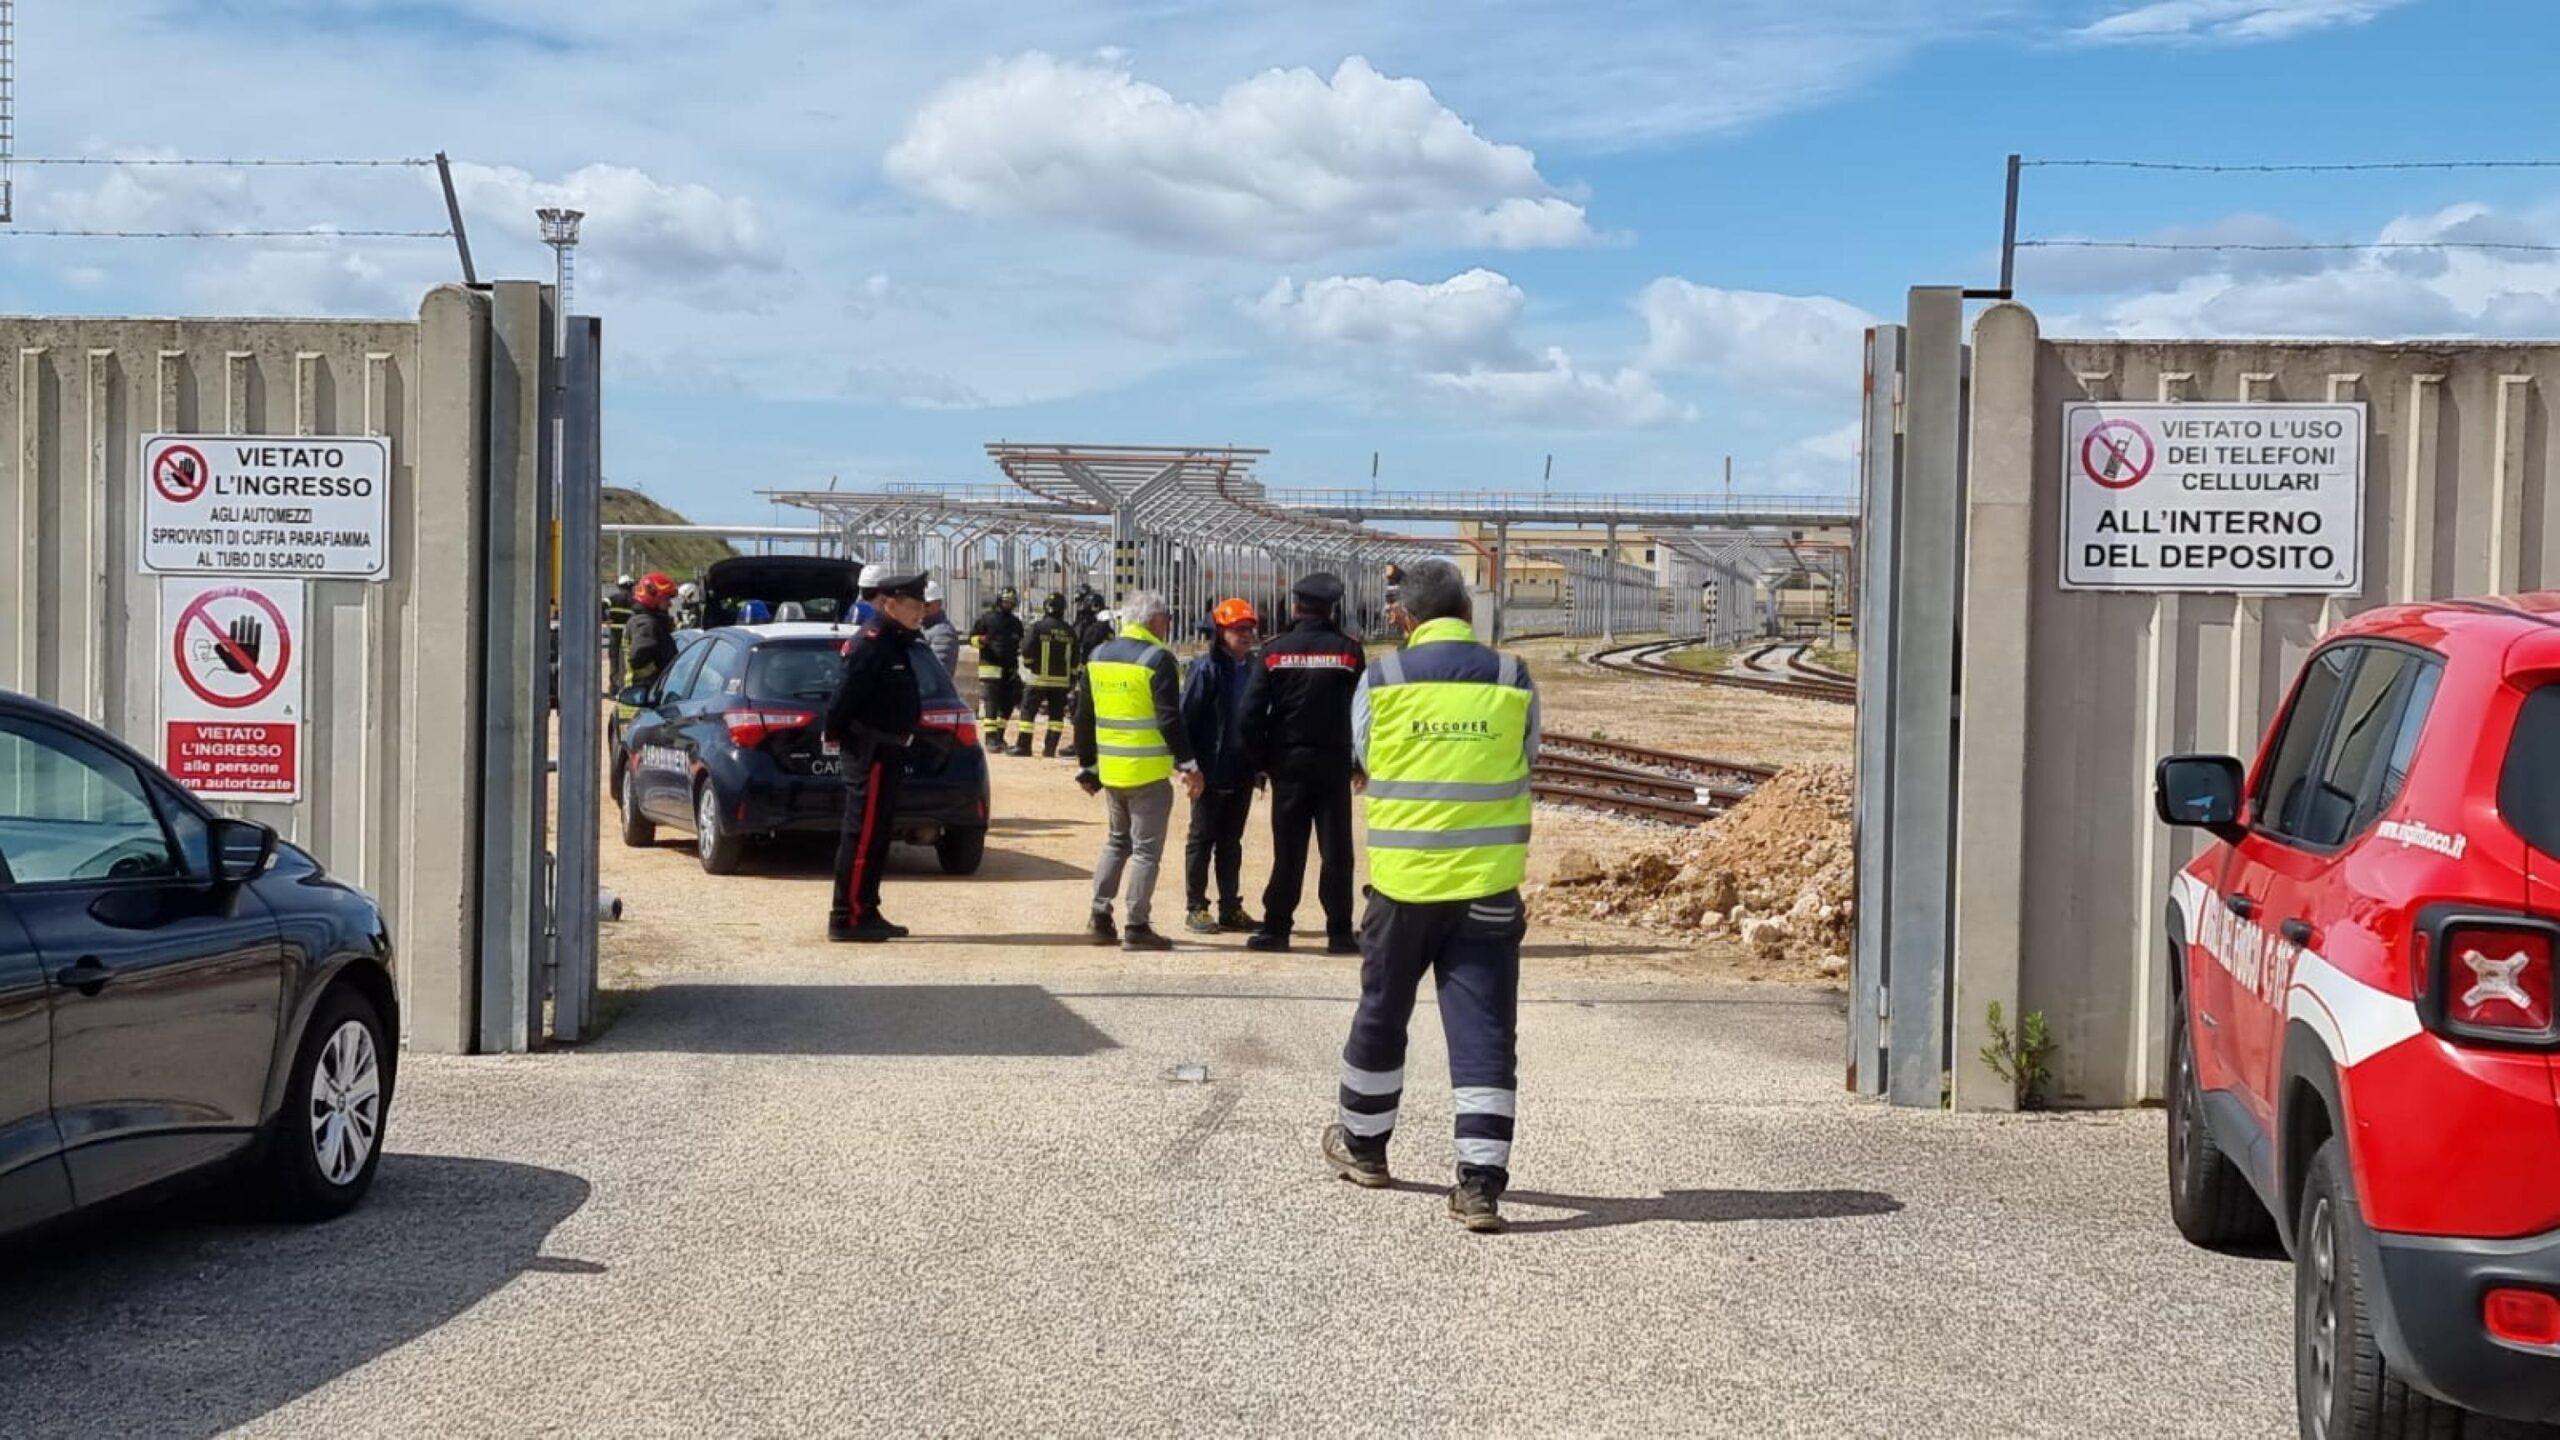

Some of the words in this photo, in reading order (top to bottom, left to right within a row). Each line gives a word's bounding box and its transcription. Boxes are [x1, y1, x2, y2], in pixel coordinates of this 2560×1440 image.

[2162, 420, 2262, 440] VIETATO
[2270, 420, 2343, 440] L'USO
[237, 447, 344, 468] VIETATO
[2168, 446, 2208, 465] DEI
[2214, 446, 2335, 466] TELEFONI
[215, 475, 372, 497] L'INGRESSO
[2182, 473, 2319, 491] CELLULARI
[210, 507, 238, 523] AGLI
[242, 507, 313, 524] AUTOMEZZI
[2096, 510, 2322, 535] ALL'INTERNO
[152, 528, 224, 545] SPROVVISTI
[227, 530, 240, 545] DI
[243, 530, 286, 546] CUFFIA
[289, 531, 371, 547] PARAFIAMMA
[197, 552, 214, 567] AL
[216, 552, 250, 568] TUBO
[253, 553, 266, 568] DI
[269, 553, 325, 569] SCARICO
[2084, 544, 2149, 568] DEL
[2160, 545, 2334, 570] DEPOSITO
[1280, 653, 1343, 667] CARABINIERI
[197, 726, 266, 740] VIETATO
[181, 743, 282, 757] L'INGRESSO
[183, 760, 211, 772] alle
[215, 762, 279, 775] persone
[205, 776, 292, 790] autorizzate
